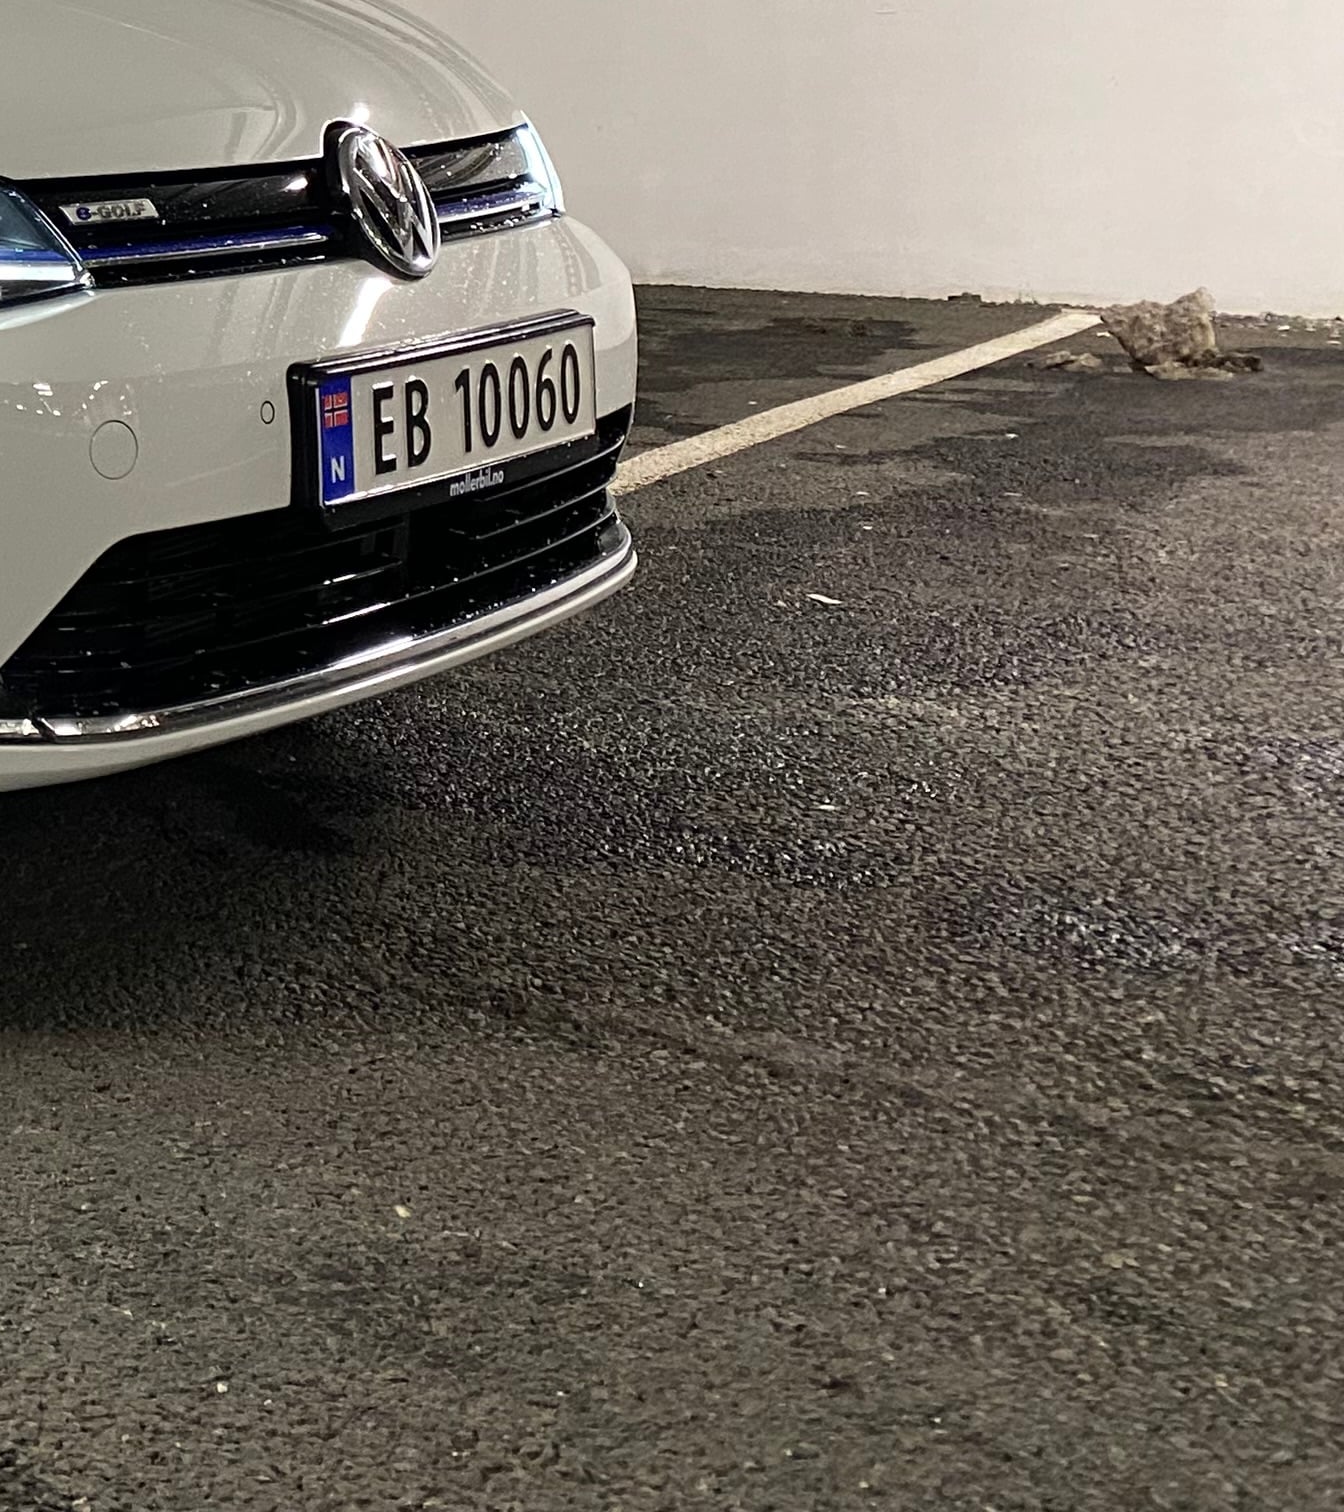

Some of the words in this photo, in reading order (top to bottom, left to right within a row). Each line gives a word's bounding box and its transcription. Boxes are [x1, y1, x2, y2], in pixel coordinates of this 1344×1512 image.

[372, 376, 432, 475] EB
[454, 343, 580, 453] 10060
[331, 455, 346, 483] N
